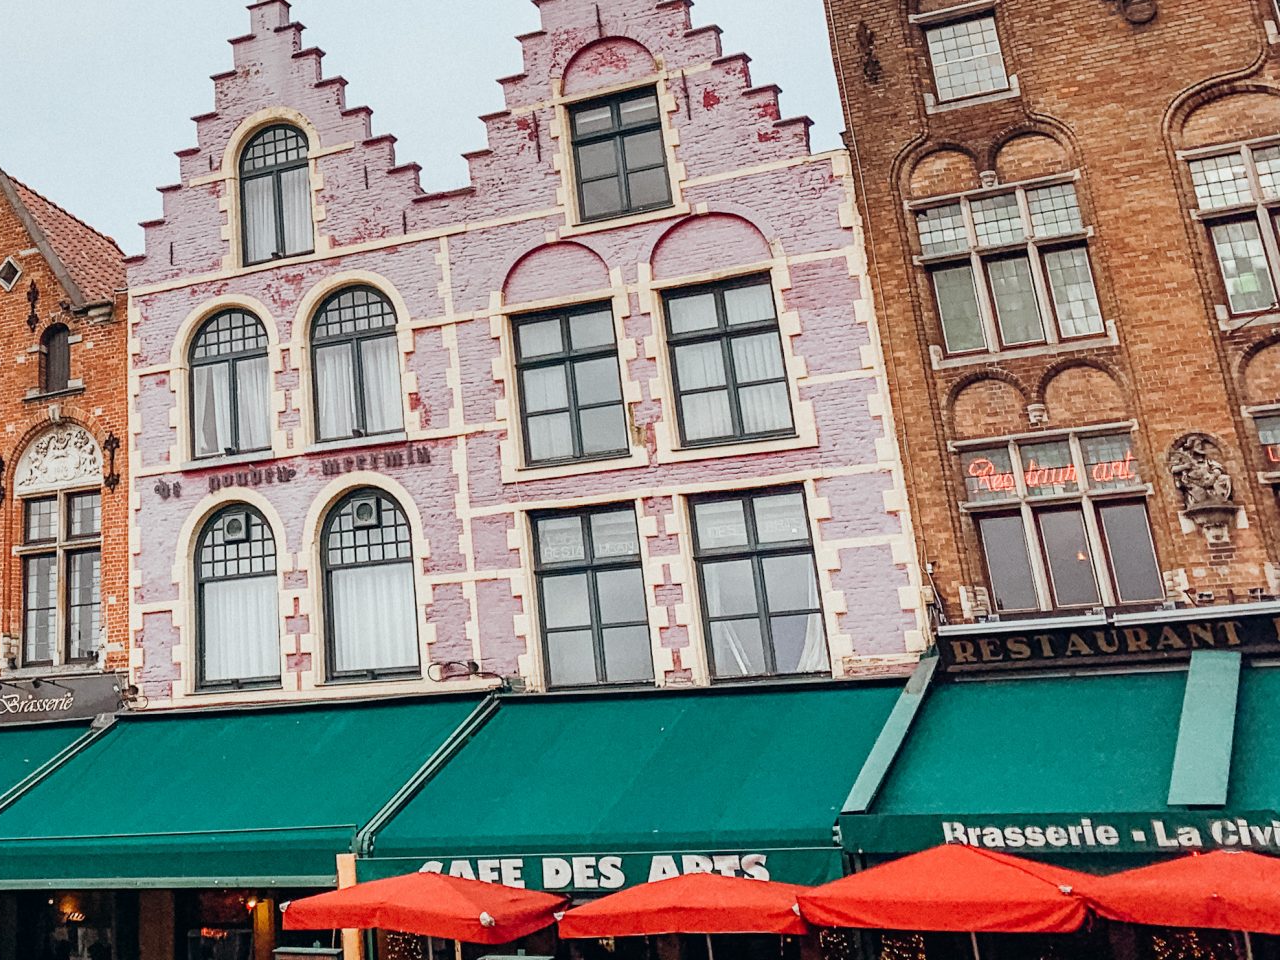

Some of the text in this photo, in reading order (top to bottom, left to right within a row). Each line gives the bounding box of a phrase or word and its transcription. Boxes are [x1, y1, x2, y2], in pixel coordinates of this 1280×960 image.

[949, 621, 1242, 664] RESTAURANT
[942, 818, 1120, 848] Brasserie
[1151, 819, 1204, 848] La
[542, 855, 626, 889] DES
[648, 853, 770, 883] ARTS
